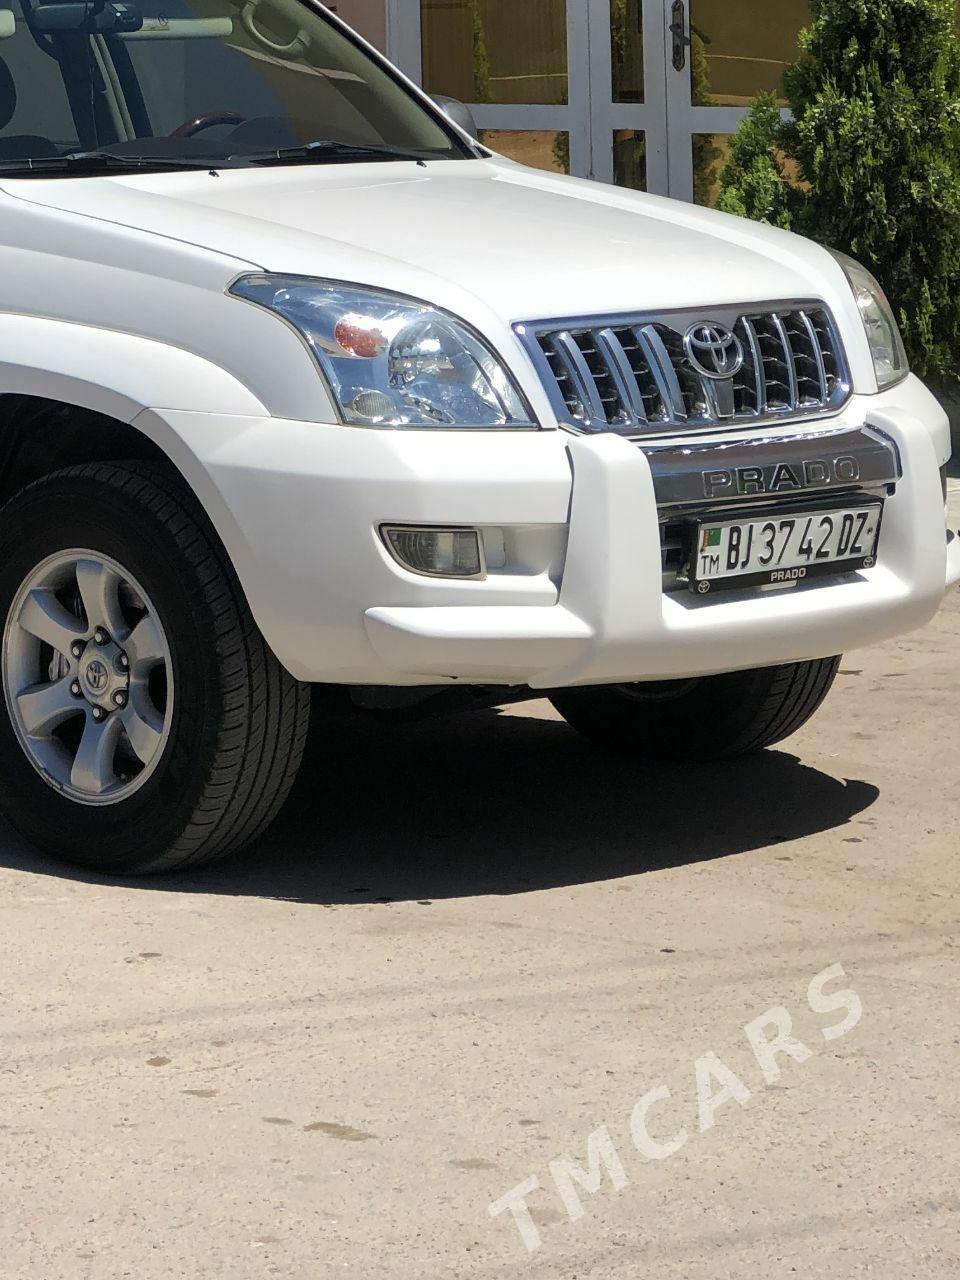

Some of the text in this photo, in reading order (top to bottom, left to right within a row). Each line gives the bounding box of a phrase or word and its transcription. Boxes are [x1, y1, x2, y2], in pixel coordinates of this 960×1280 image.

[702, 456, 860, 497] PRADO
[701, 554, 720, 575] TM
[770, 567, 807, 582] PRADO
